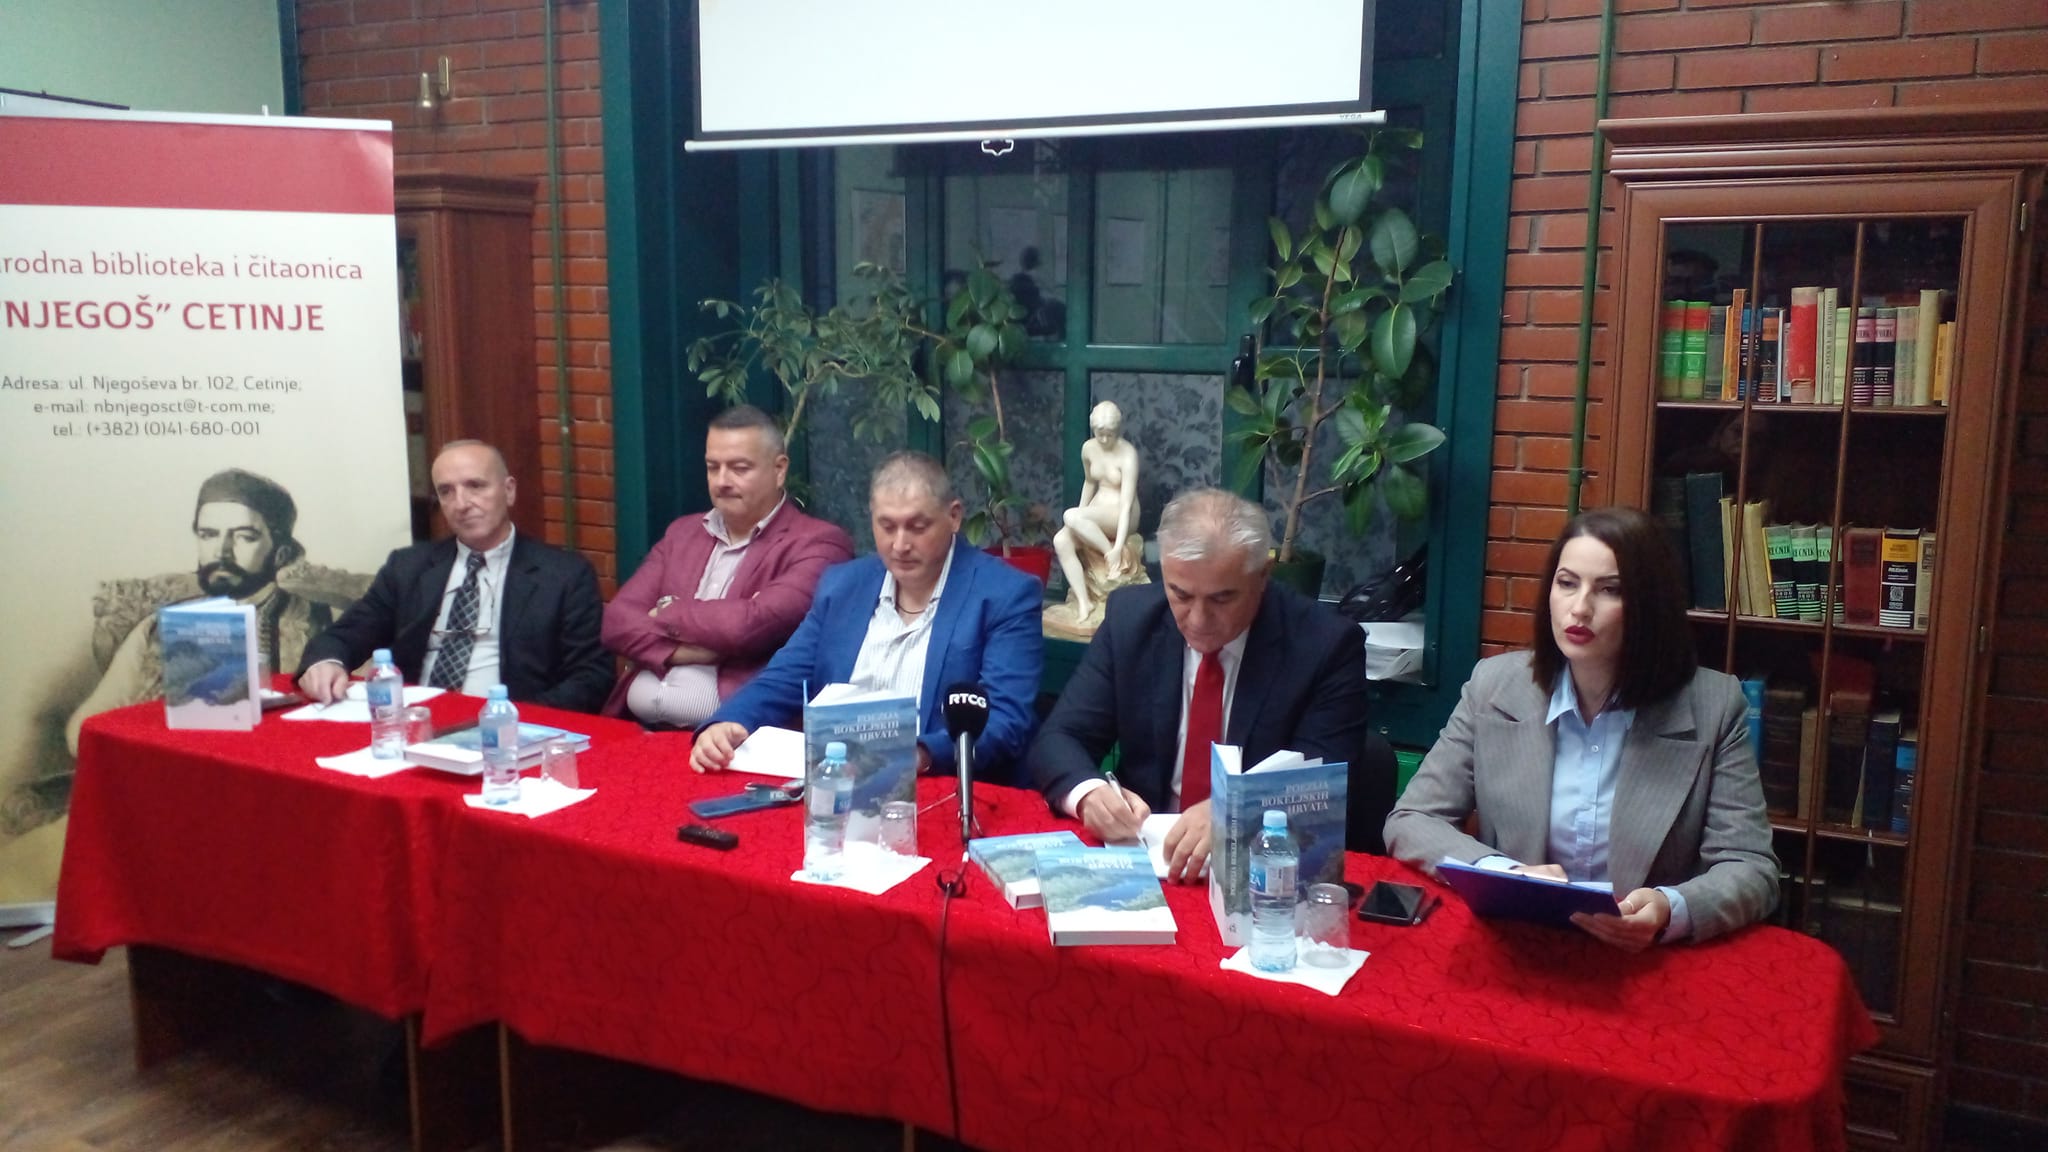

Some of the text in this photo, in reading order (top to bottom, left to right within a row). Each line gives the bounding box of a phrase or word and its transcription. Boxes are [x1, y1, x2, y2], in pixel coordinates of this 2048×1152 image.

[0, 250, 363, 280] rodna biblioteka i čitaonica
[0, 294, 325, 332] NJEGOŠ” CETINJE
[1, 375, 62, 391] Adresa:
[92, 375, 178, 394] Njegoševa
[33, 399, 89, 413] e-mail:
[86, 421, 140, 437] (+382)
[144, 421, 261, 437] (0)41-680-001
[948, 692, 988, 709] RTCG
[1287, 801, 1330, 815] HRVATA
